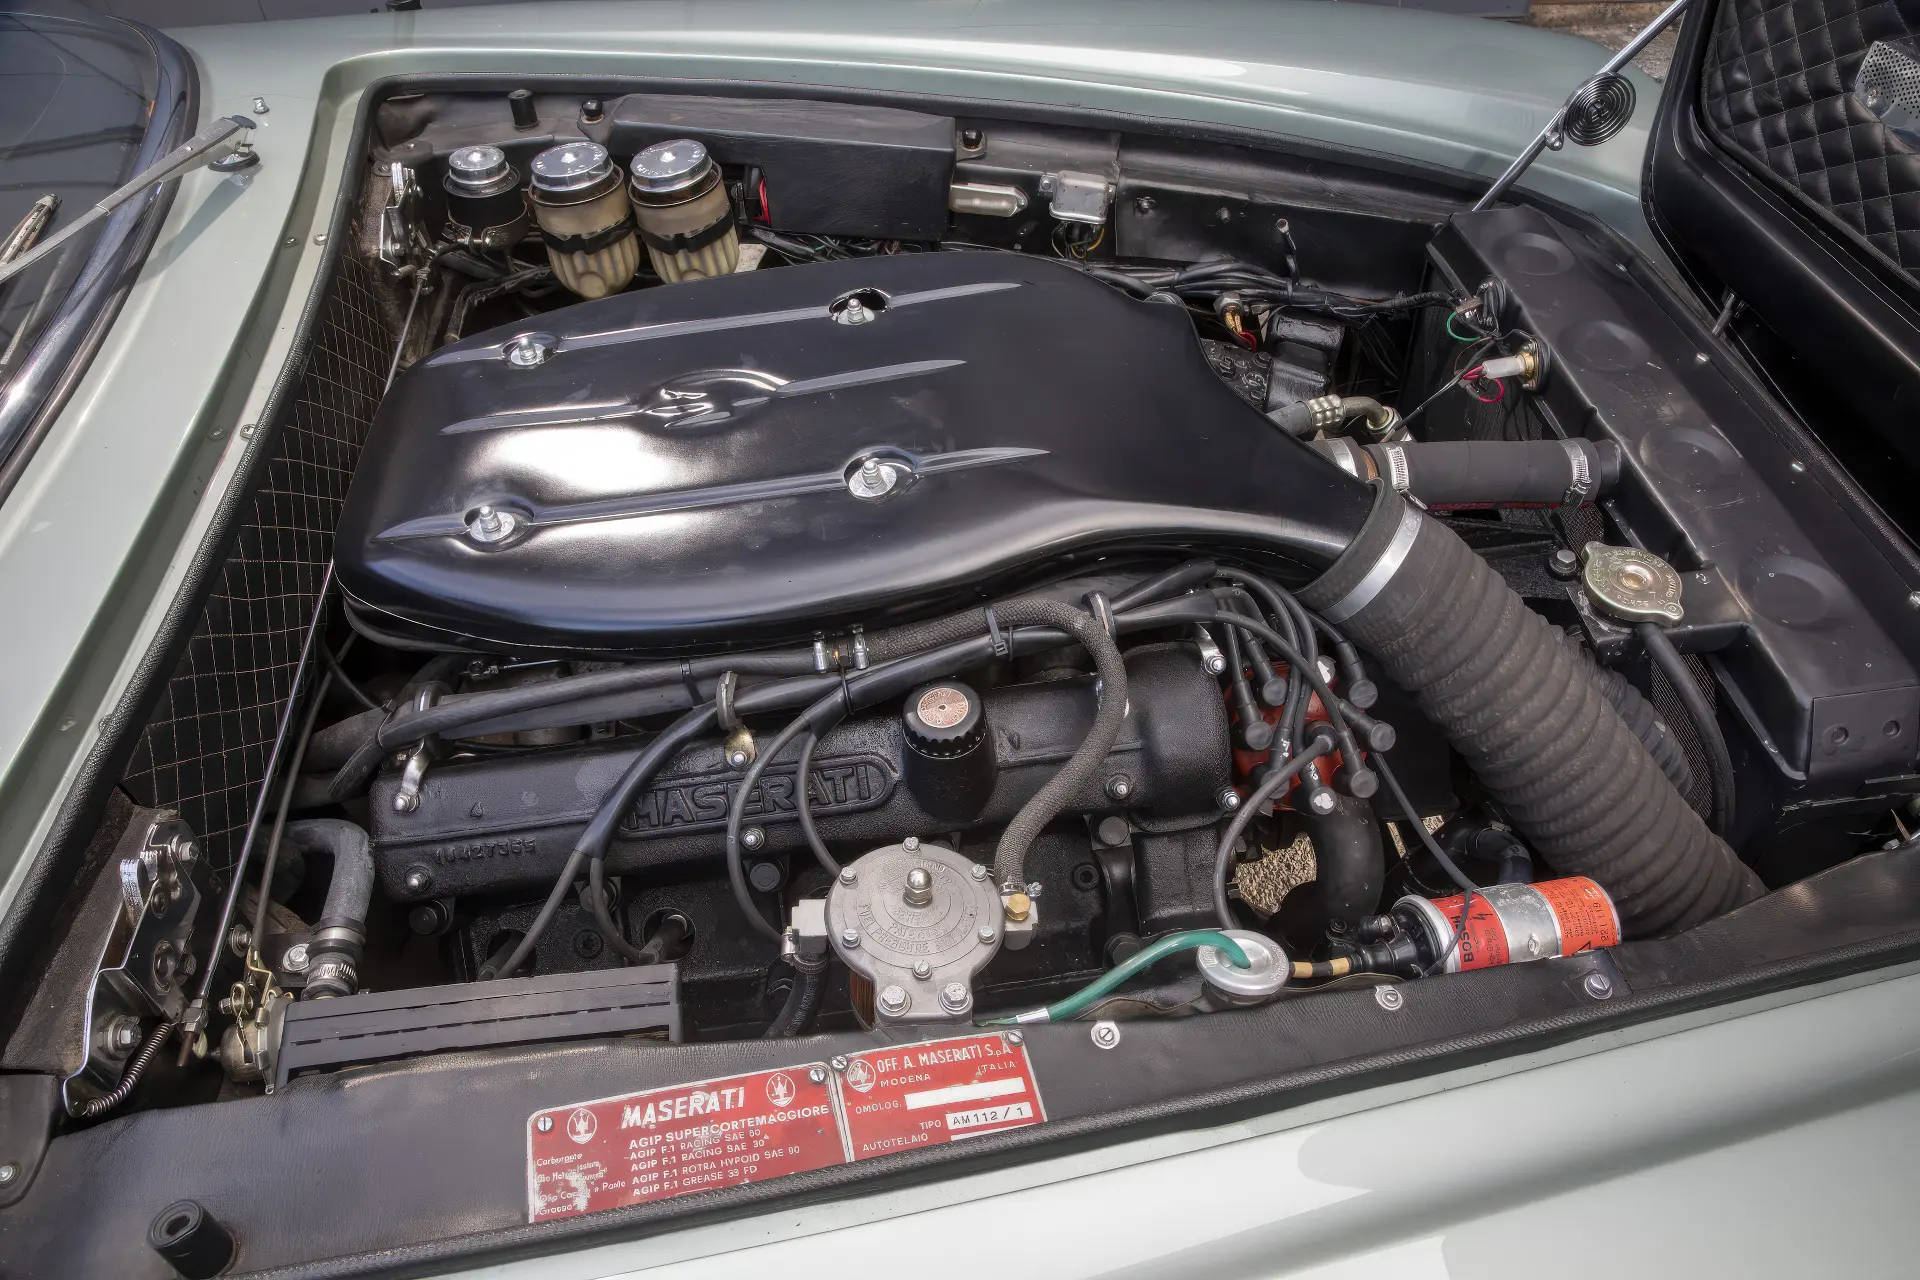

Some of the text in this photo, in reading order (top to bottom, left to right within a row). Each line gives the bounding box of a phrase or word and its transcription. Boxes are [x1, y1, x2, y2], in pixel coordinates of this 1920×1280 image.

[624, 764, 871, 830] MASERATI
[1450, 915, 1475, 963] BOSH
[877, 1057, 901, 1073] OFF.
[904, 1055, 916, 1069] A.
[919, 1045, 982, 1066] MASERATI
[981, 1061, 1017, 1075] ITALIA
[880, 1073, 931, 1087] MODENA
[621, 1087, 745, 1129] MASERATI
[629, 1104, 829, 1149] AGIP SUPERCORTEMAGGIORE
[919, 1120, 942, 1130] TIPO
[630, 1148, 656, 1160] AGIP
[680, 1137, 720, 1150] RACING
[725, 1131, 745, 1142] SAE
[862, 1133, 928, 1152] AUTOTELAIO
[631, 1160, 658, 1172] AGIP
[681, 1148, 722, 1161] RACING
[727, 1143, 747, 1153] SAE
[632, 1173, 659, 1185] AGIP
[682, 1162, 716, 1175] ROTRA
[764, 1148, 784, 1159] SAE
[633, 1184, 660, 1196] AGIP
[682, 1171, 723, 1186] GREASE
[743, 1165, 757, 1174] FD
